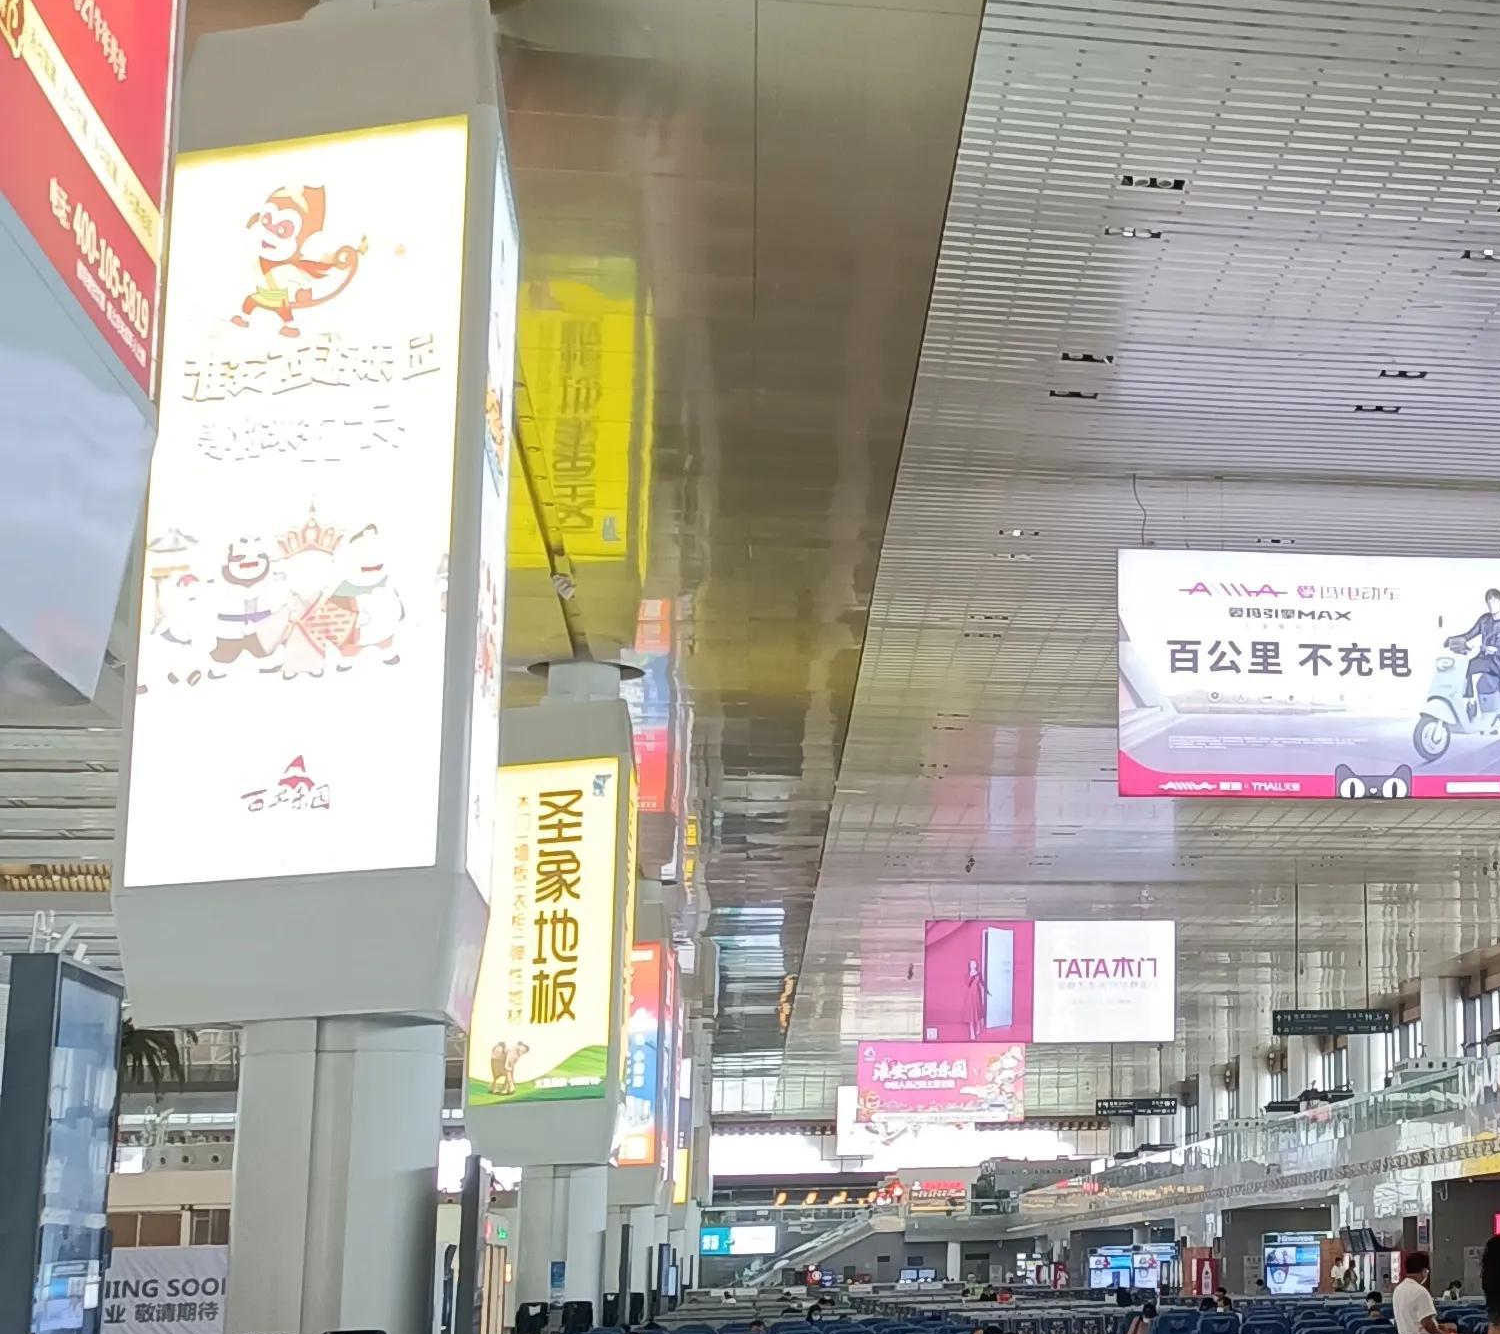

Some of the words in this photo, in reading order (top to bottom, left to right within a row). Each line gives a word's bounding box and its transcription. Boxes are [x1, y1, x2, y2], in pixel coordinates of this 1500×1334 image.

[1166, 639, 1284, 675] 百公里
[1298, 642, 1412, 678] 不充电
[530, 789, 583, 1024] 圣象地板
[1053, 956, 1158, 979] TATA木门
[166, 1277, 226, 1298] SOO
[135, 1302, 219, 1324] 敬请期待
